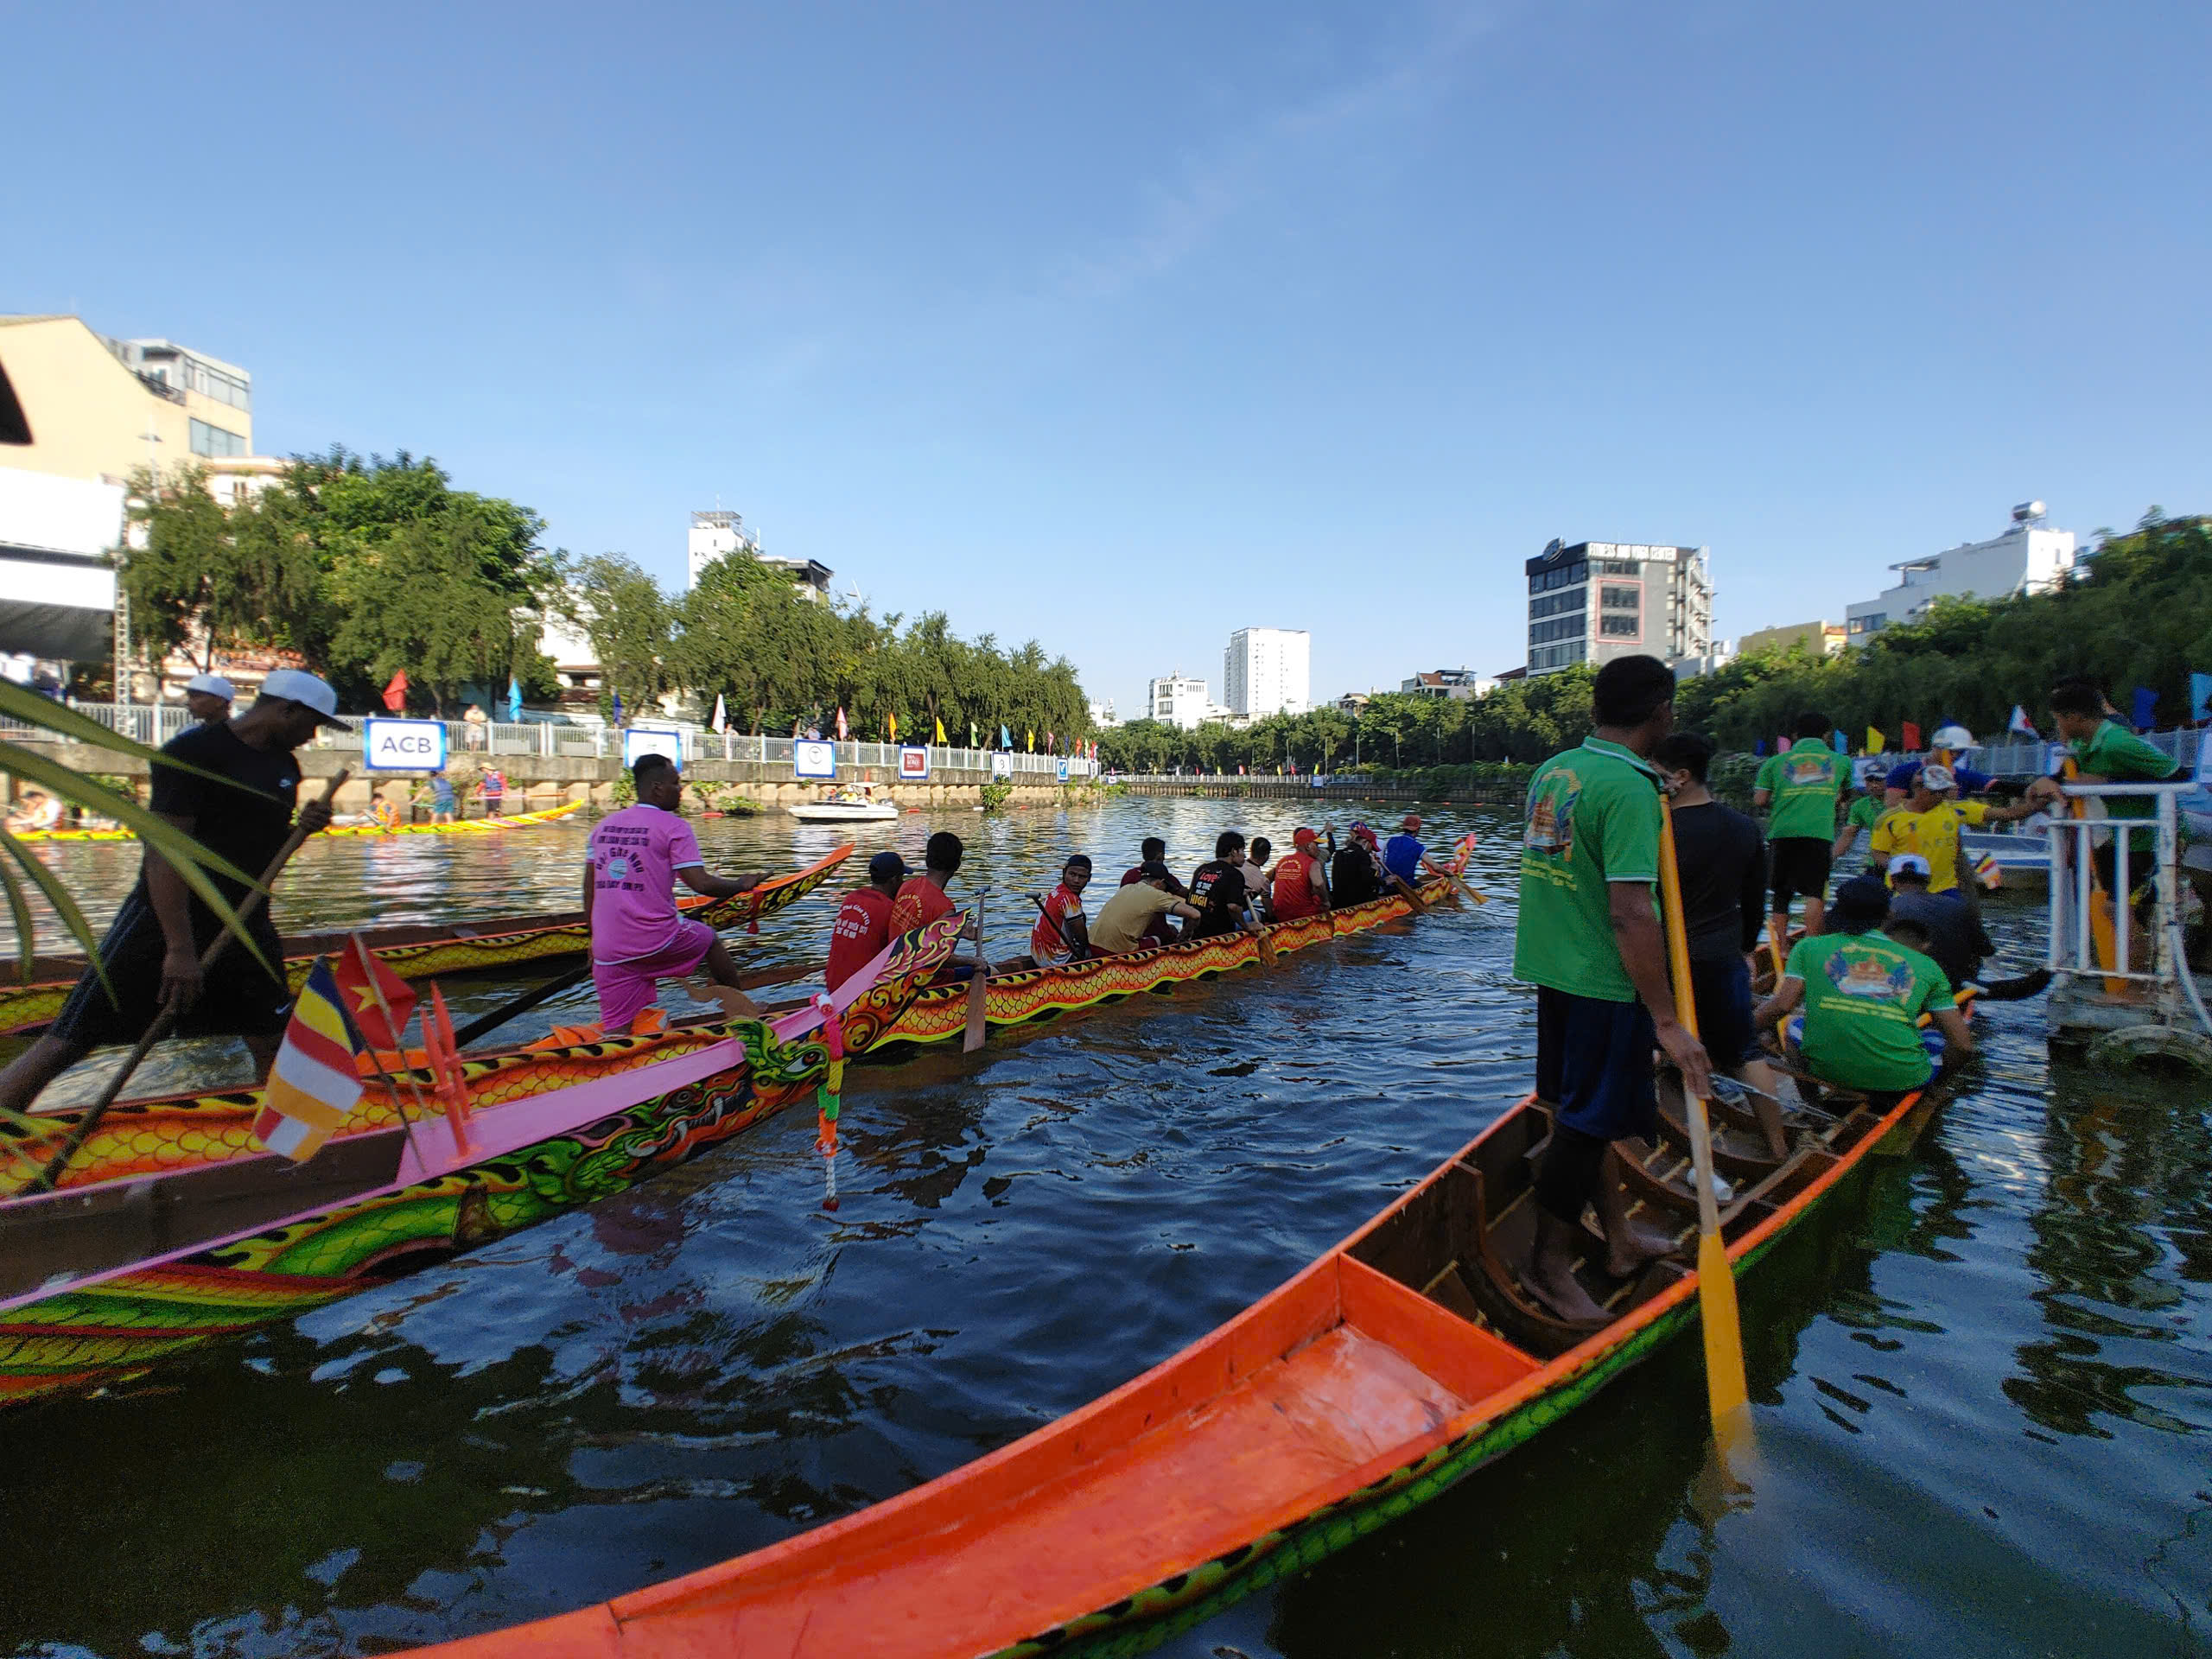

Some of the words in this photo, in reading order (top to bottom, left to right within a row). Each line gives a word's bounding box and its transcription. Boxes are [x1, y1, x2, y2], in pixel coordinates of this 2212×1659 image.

[1589, 542, 1616, 558] FITNESS
[1617, 544, 1630, 558] AND
[1631, 545, 1649, 561] YOGA
[1649, 546, 1676, 561] CENTER
[381, 736, 431, 753] ACB
[1190, 894, 1208, 907] HIGH
